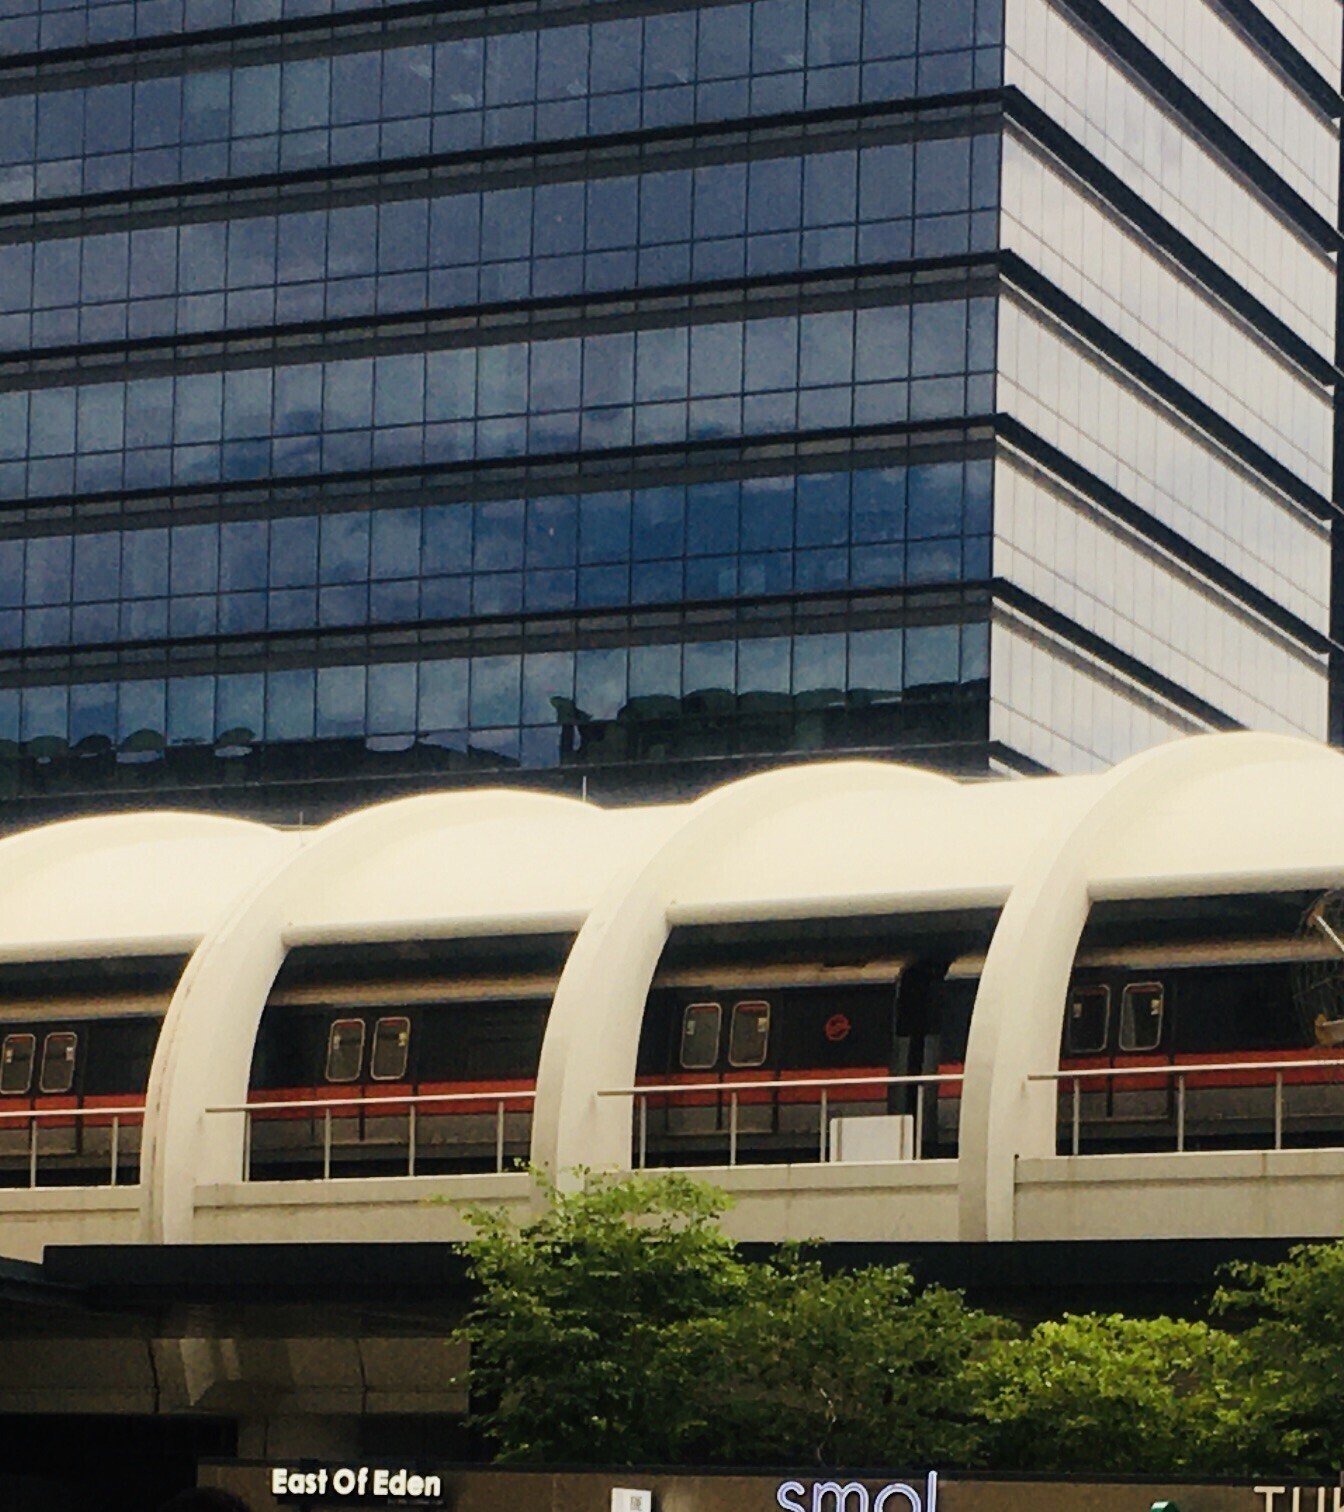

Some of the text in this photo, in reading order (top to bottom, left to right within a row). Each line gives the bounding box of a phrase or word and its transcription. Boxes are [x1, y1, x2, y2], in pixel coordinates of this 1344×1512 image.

[272, 1467, 441, 1497] East Of Eden
